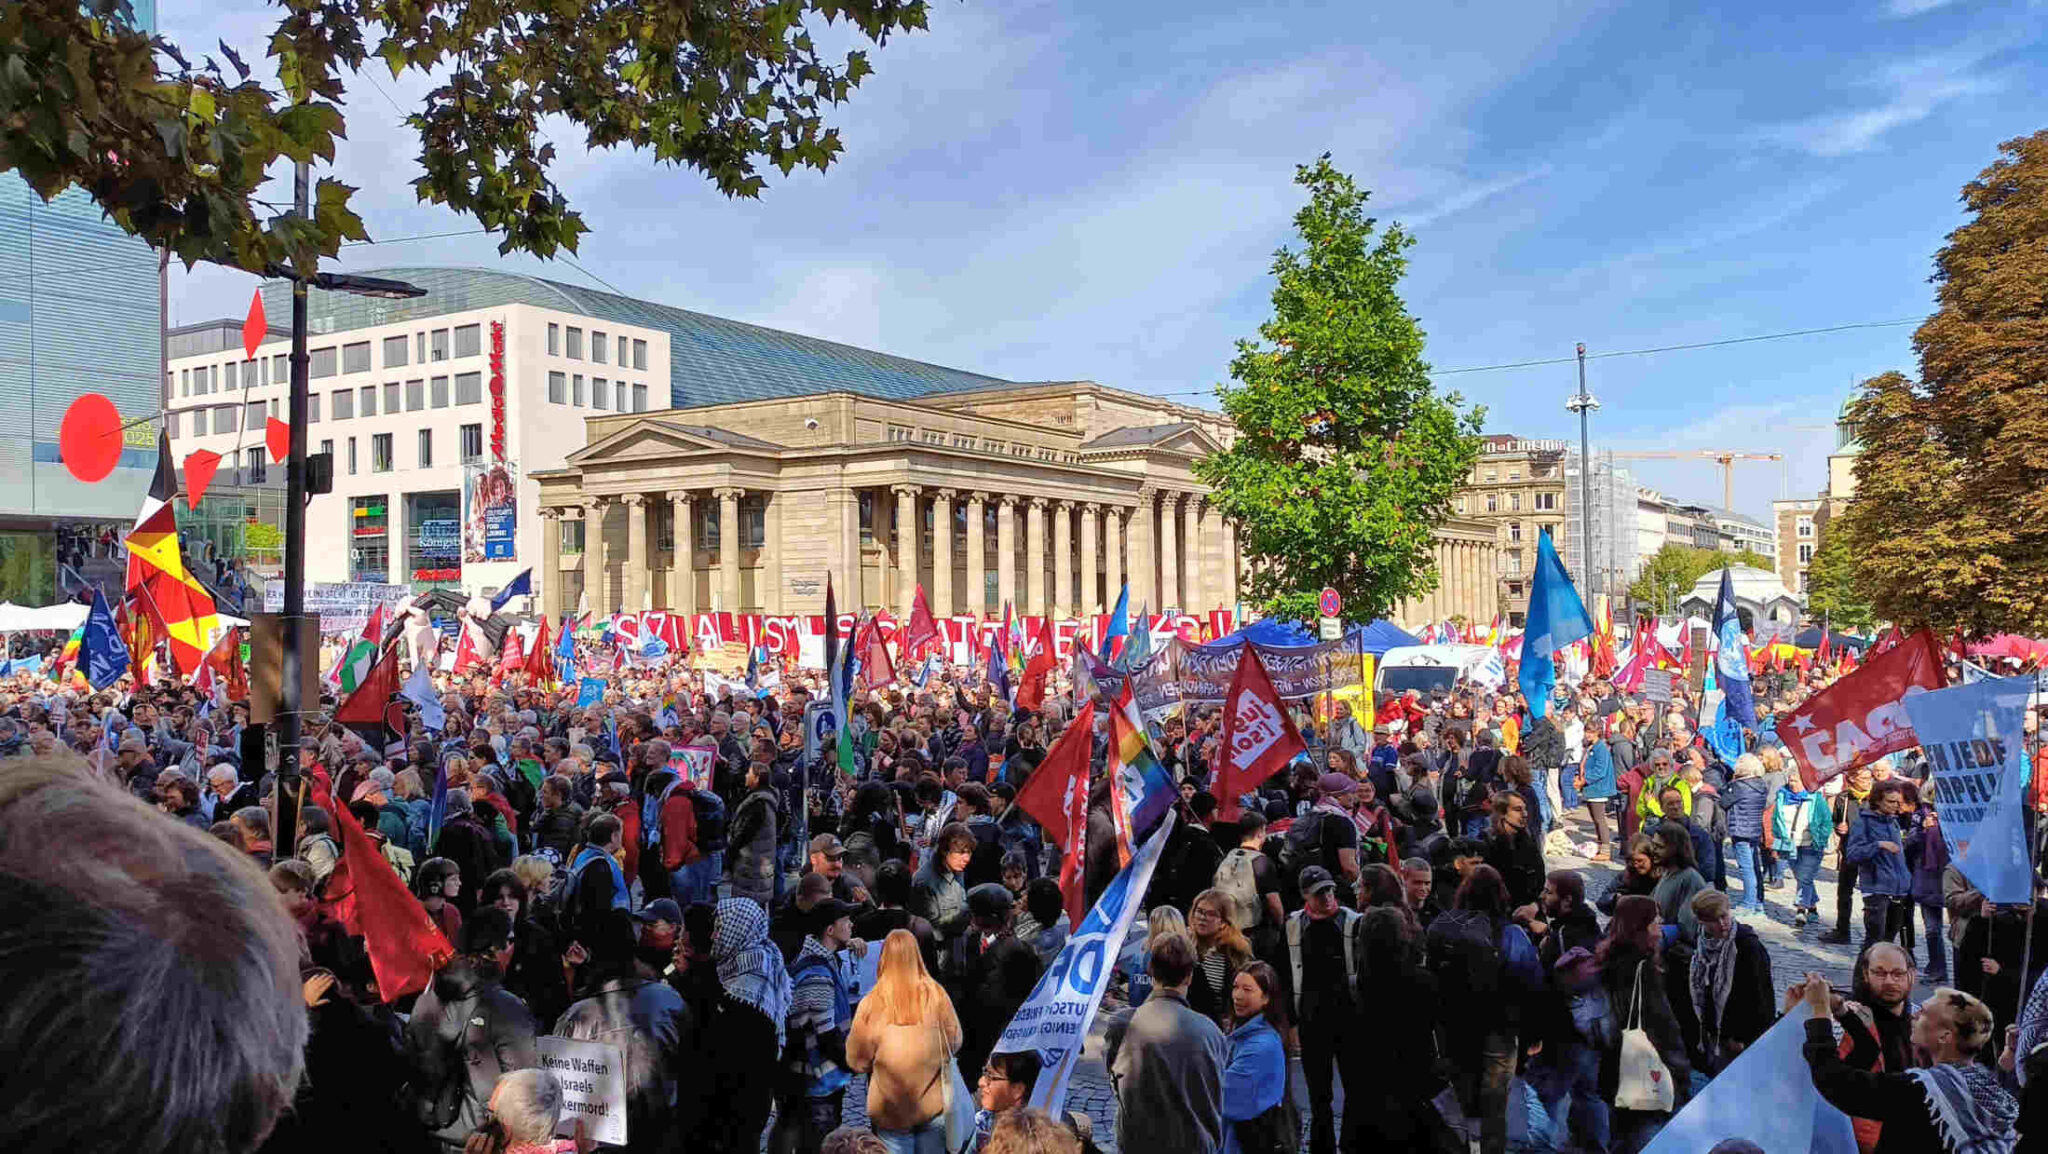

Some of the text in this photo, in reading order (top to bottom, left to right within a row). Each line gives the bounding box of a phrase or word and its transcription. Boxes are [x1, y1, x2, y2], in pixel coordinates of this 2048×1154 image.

[542, 1054, 608, 1075] Keine Waffen
[561, 1076, 593, 1093] Israels
[563, 1100, 609, 1117] kermord!
